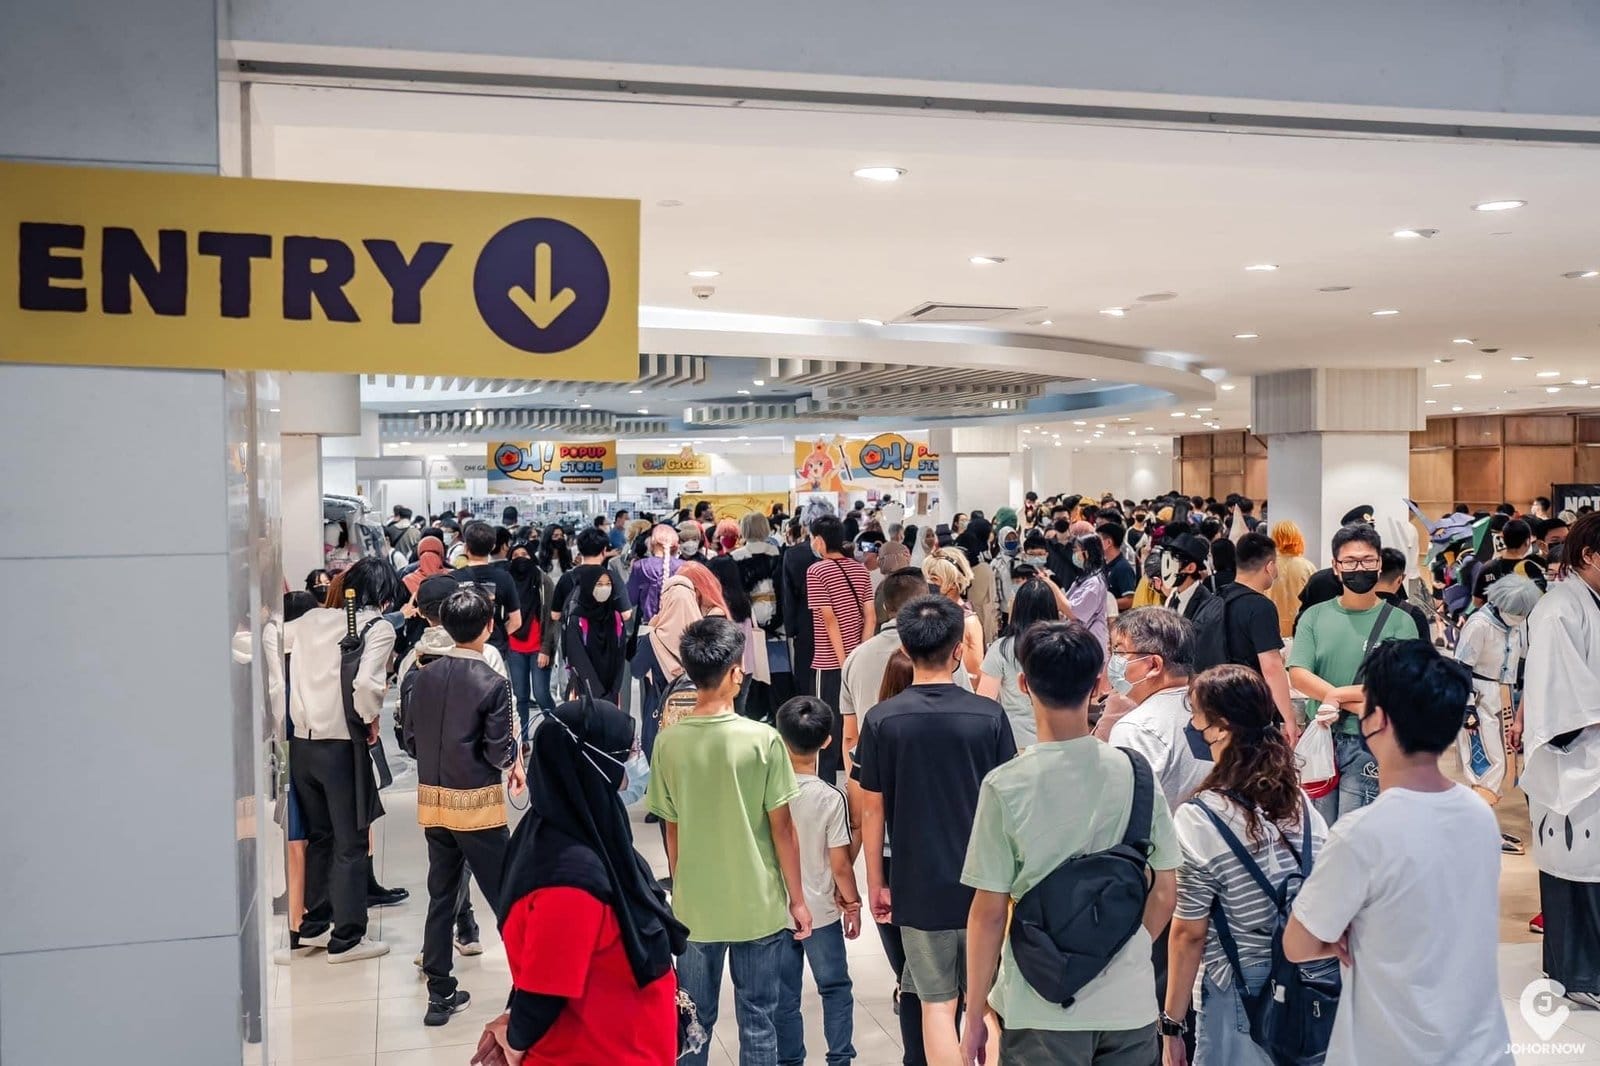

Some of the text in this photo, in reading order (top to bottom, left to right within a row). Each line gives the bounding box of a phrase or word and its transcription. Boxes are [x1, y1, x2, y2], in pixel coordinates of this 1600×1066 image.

[19, 221, 453, 325] ENTRY
[494, 442, 555, 472] OH!
[560, 447, 607, 459] POPUP
[560, 461, 603, 473] STORE
[859, 442, 914, 471] OH!
